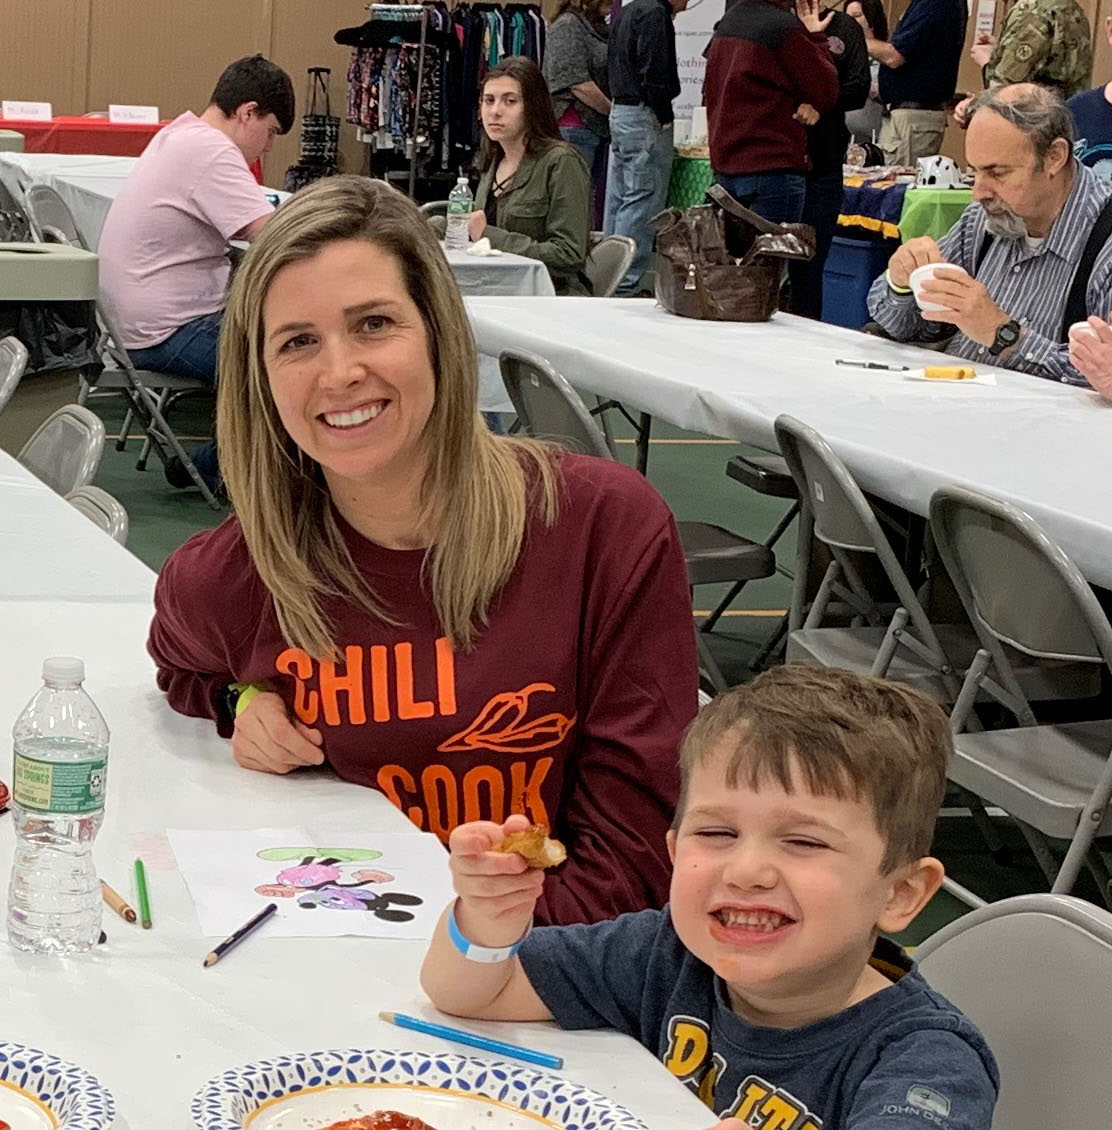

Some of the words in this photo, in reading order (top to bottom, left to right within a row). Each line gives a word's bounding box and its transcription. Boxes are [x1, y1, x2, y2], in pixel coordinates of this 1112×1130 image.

[275, 637, 458, 727] CHILI
[376, 757, 554, 846] COOK
[879, 1104, 920, 1116] JOHN
